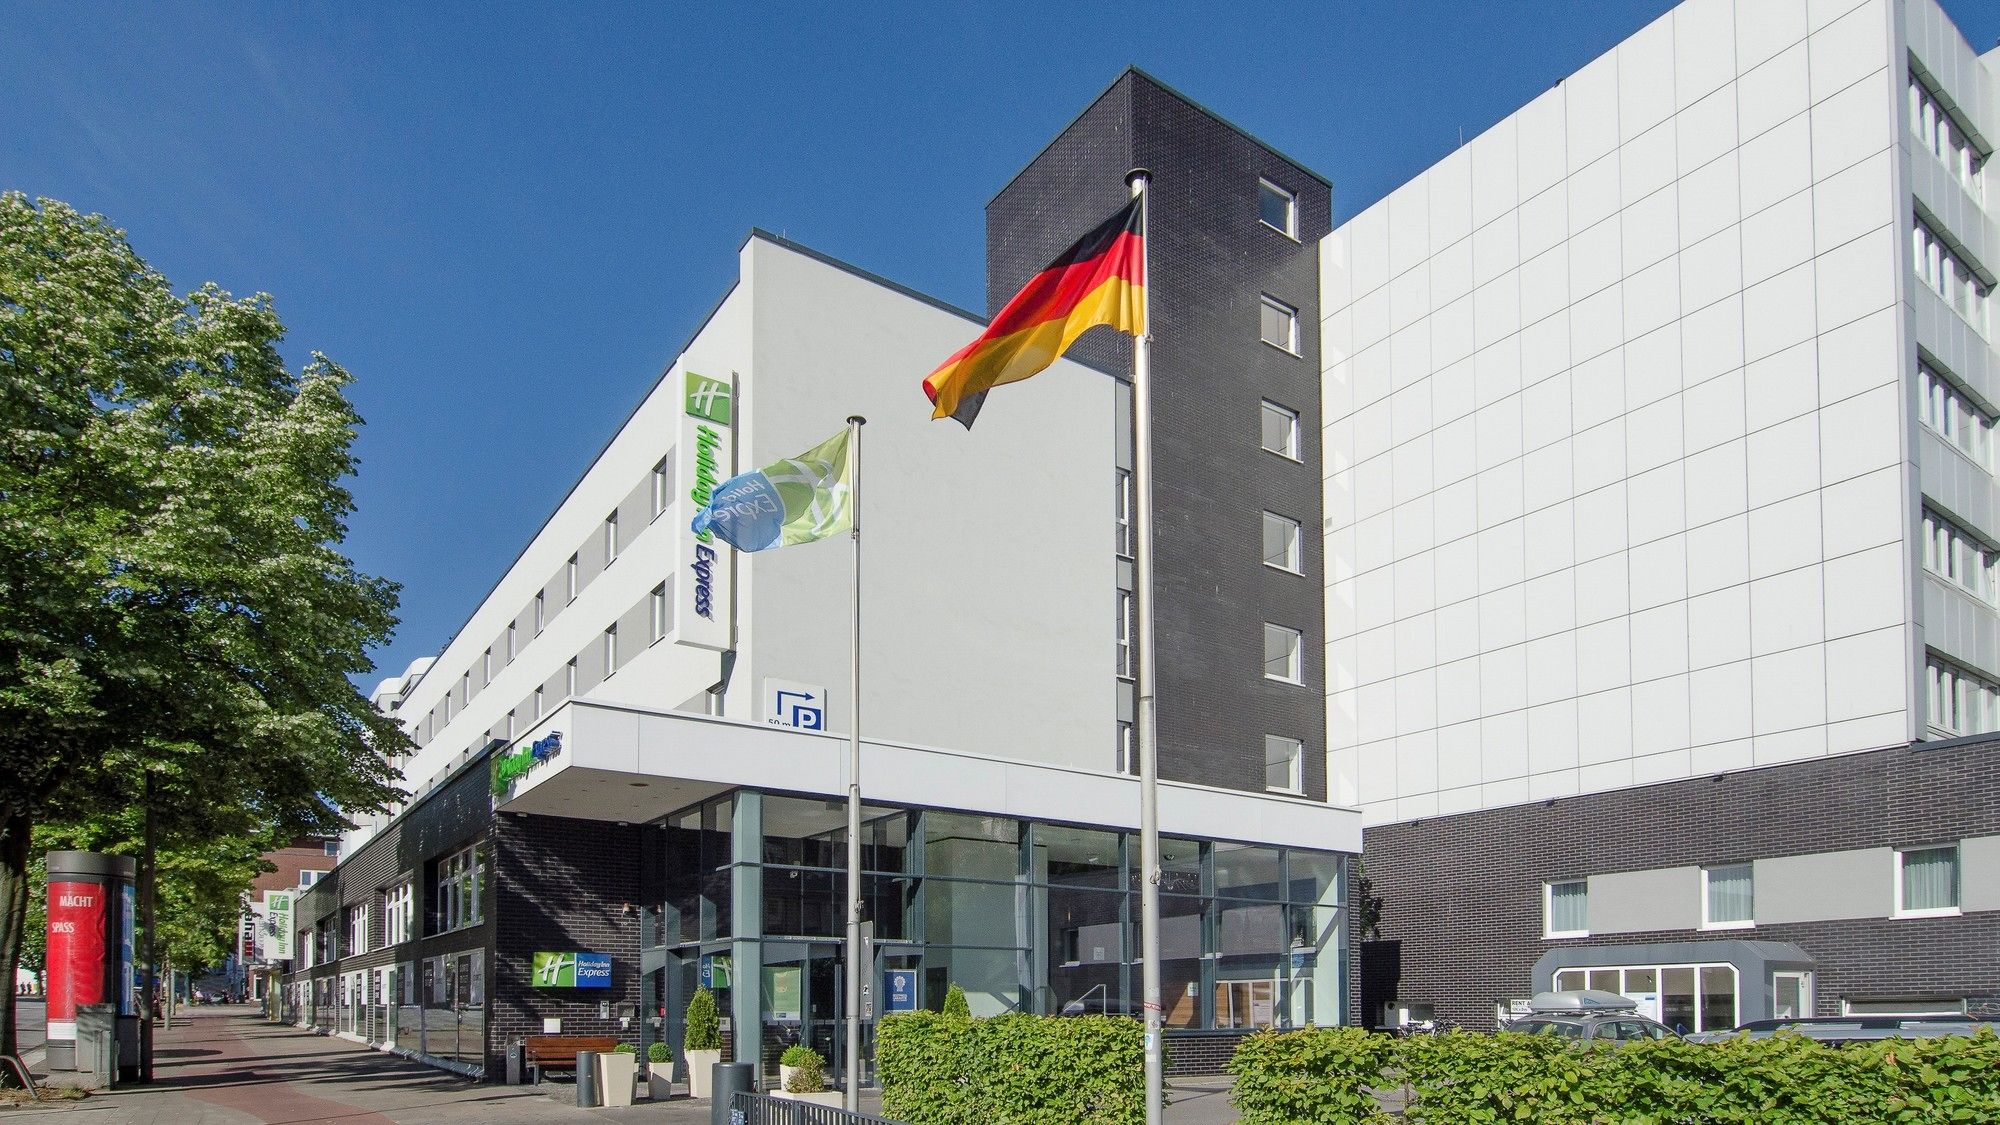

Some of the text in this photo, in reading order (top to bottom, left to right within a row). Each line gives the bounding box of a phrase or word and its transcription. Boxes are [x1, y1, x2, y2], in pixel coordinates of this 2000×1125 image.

[691, 425, 717, 508] Holiday
[691, 544, 715, 620] Express
[59, 895, 93, 907] MACHT
[51, 921, 75, 933] SPASS
[577, 967, 610, 978] Express
